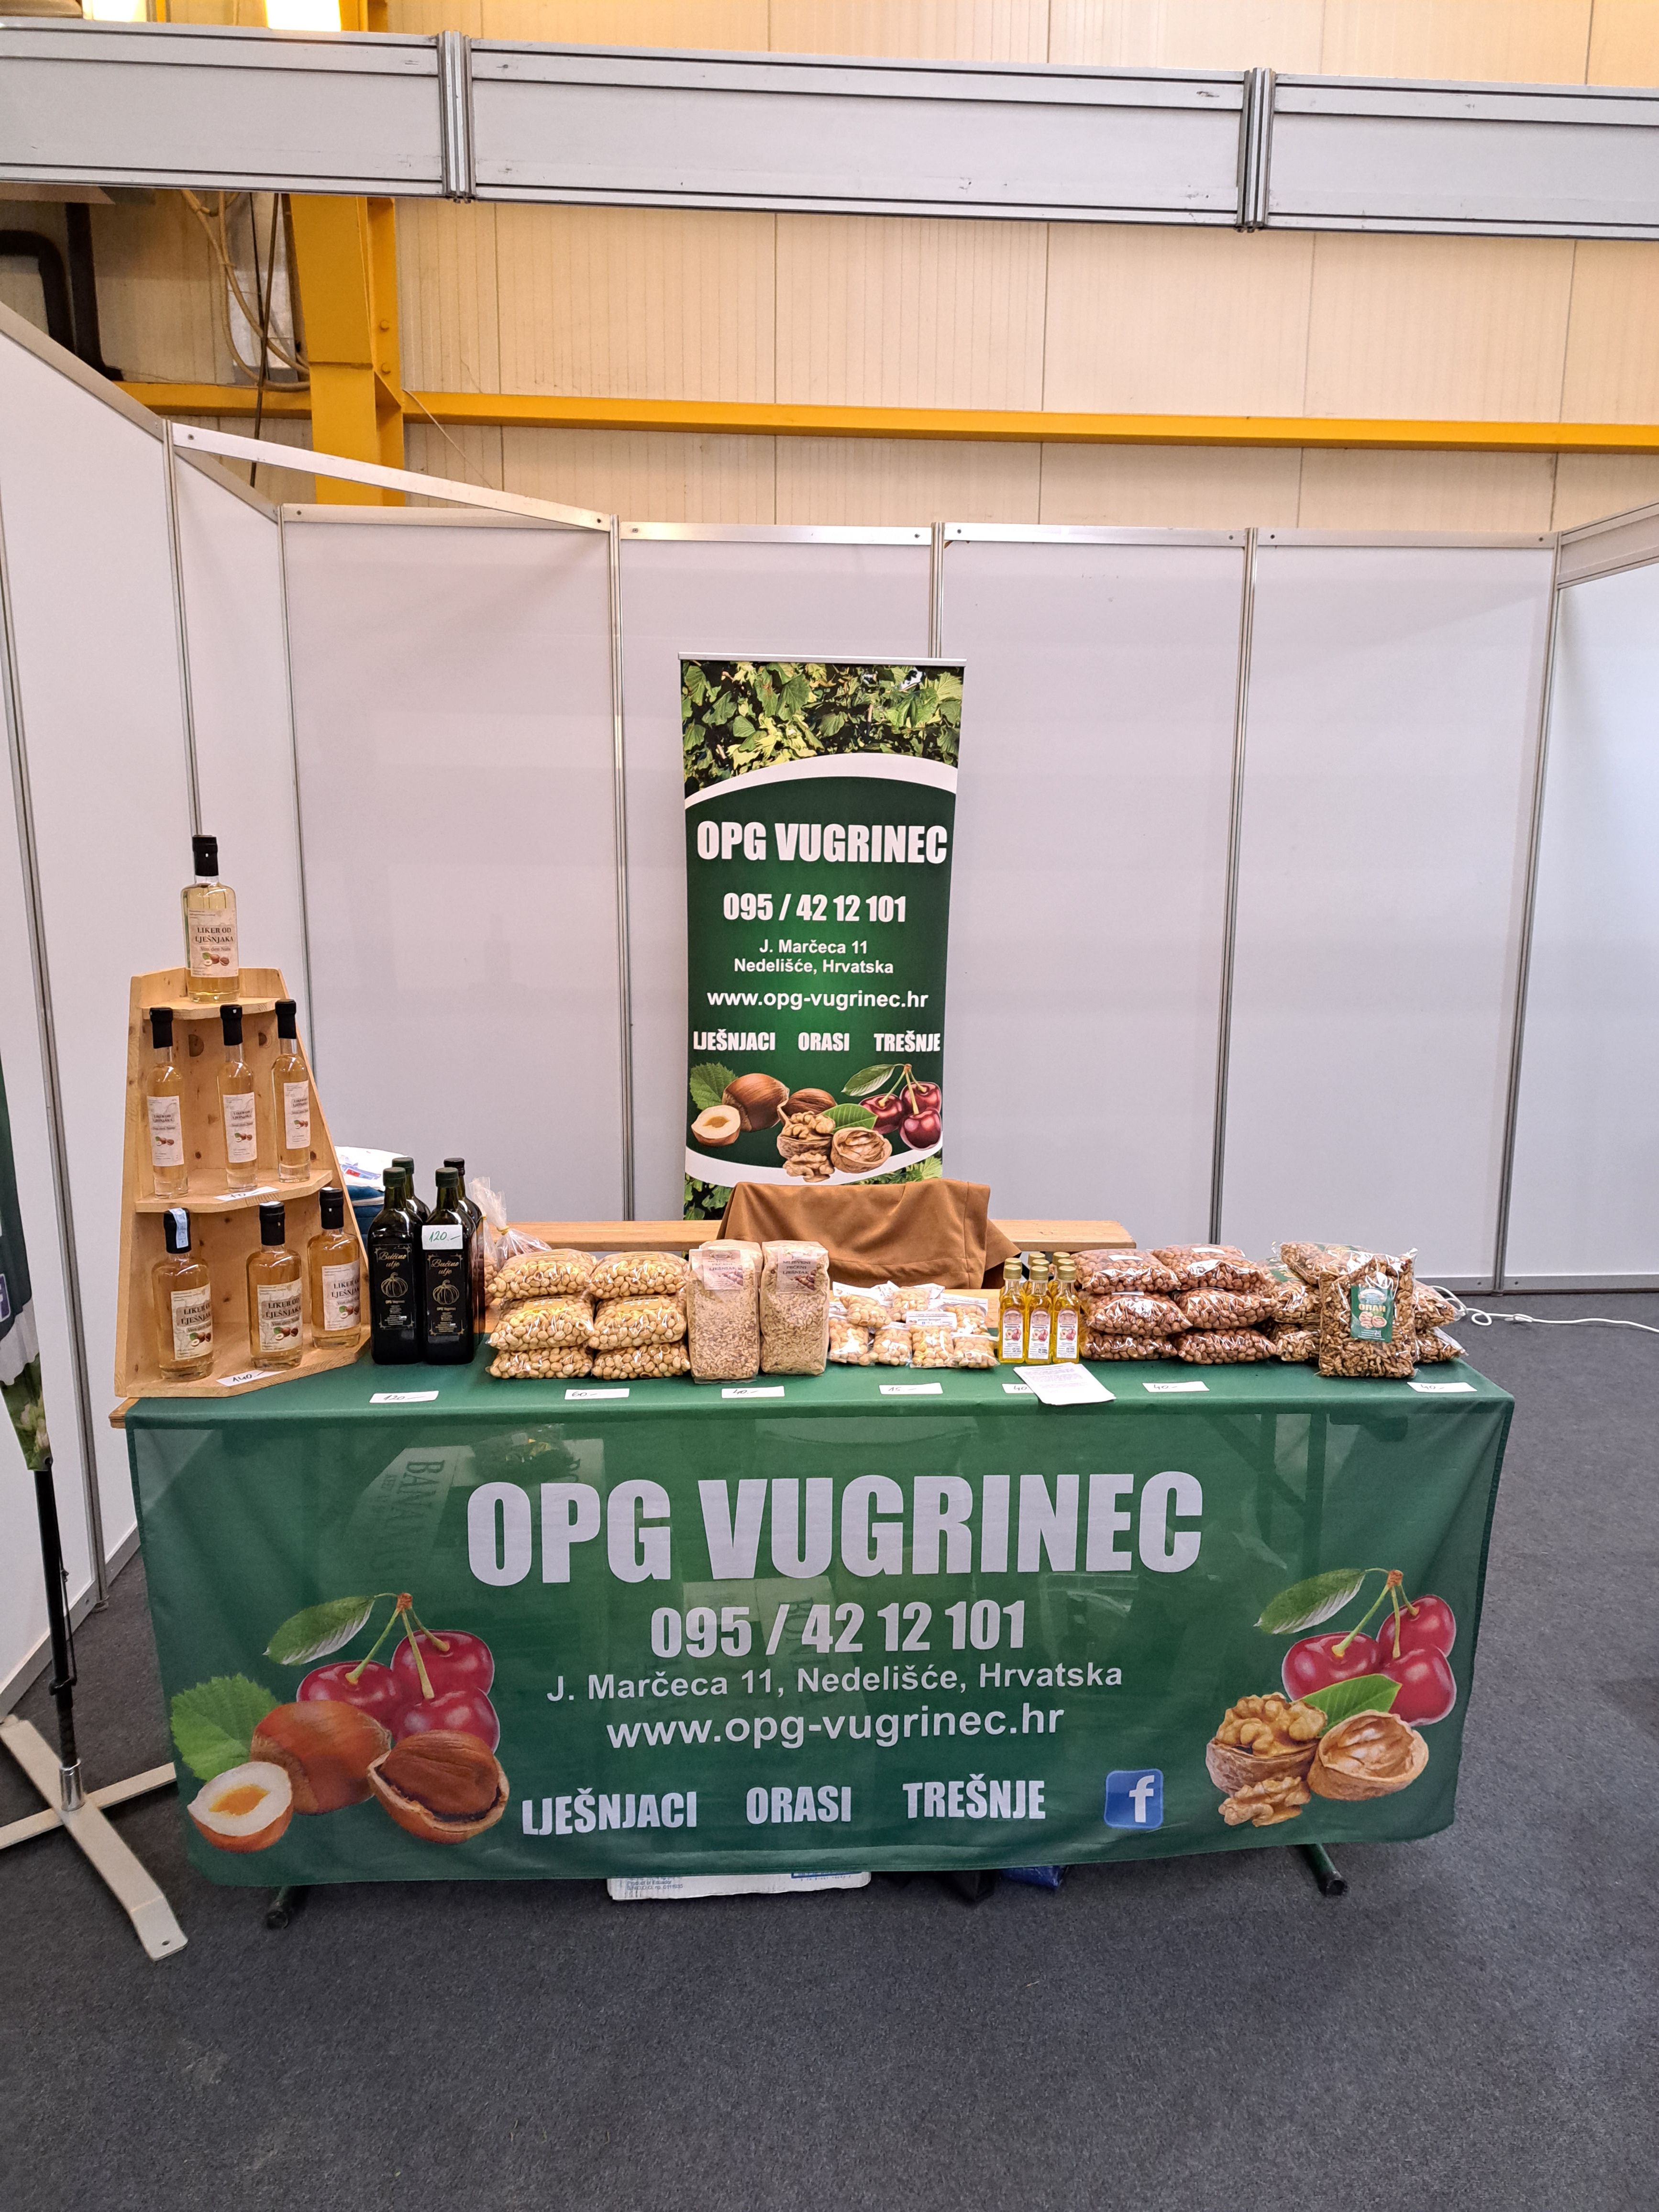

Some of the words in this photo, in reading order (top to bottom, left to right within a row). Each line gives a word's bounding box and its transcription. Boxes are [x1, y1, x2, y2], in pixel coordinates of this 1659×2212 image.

[697, 820, 766, 861] OPG
[774, 823, 947, 863] VUGRINEC
[723, 893, 773, 920] 095
[778, 894, 791, 921] /
[796, 894, 828, 921] 42
[833, 895, 860, 921] 12
[865, 896, 906, 922] 101
[759, 940, 773, 954] J.
[778, 939, 845, 954] Marčeca
[852, 941, 867, 954] 11
[734, 958, 817, 974] Nedelišće,
[822, 960, 893, 973] Hrvatska
[707, 991, 929, 1011] www.opg-vugrinec.hr
[693, 1029, 775, 1051] LJEŠNJACI
[798, 1032, 850, 1051] ORASI
[874, 1030, 940, 1051] TREŠNJE
[438, 1268, 452, 1276] ulje
[184, 1306, 205, 1315] LIKER
[467, 1479, 671, 1586] OPG
[697, 1471, 1203, 1580] VUGRINEC
[651, 1606, 752, 1658] 095
[765, 1604, 790, 1655] /
[801, 1602, 864, 1654] 42
[877, 1602, 932, 1652] 12
[944, 1599, 1025, 1650] 101
[547, 1676, 575, 1702] J.
[588, 1671, 728, 1700] Marčeca
[741, 1669, 784, 1697] 11,
[797, 1664, 967, 1693] Nedelišće,
[980, 1662, 1122, 1688] Hrvatska
[607, 1703, 1064, 1749] www.opg-vugrinec.hr
[746, 1786, 852, 1825] ORASI
[902, 1773, 1046, 1819] TREŠNJE
[522, 1788, 697, 1836] LJEŠNJACI
